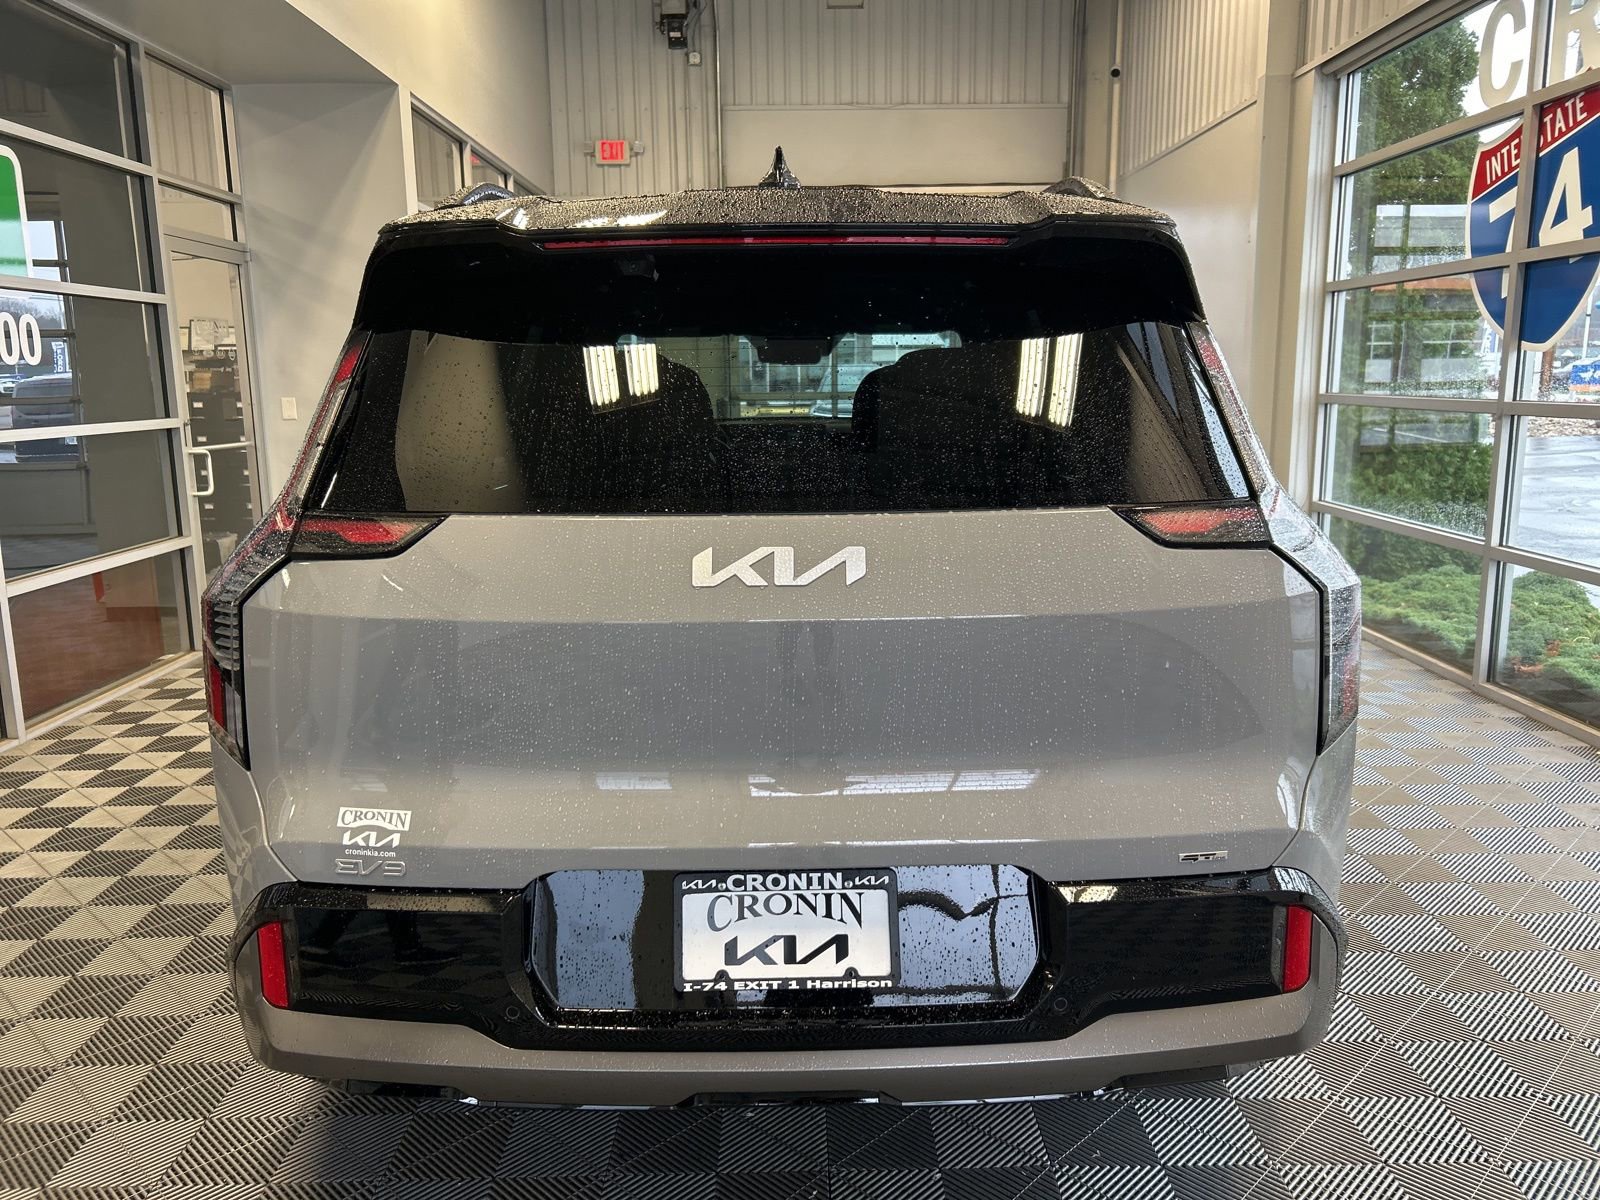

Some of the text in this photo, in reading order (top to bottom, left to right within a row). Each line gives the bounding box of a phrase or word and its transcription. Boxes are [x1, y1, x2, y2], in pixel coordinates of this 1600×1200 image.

[1485, 91, 1589, 185] INTETATE
[600, 140, 625, 161] EXIT
[691, 545, 867, 587] KIA
[341, 809, 408, 829] CRONIN
[342, 830, 401, 848] KIA
[344, 848, 396, 857] croninkia.com
[681, 872, 889, 891] KIA CRONIN KIA
[706, 892, 865, 932] CRONIN
[724, 933, 849, 966] KIA
[683, 978, 893, 992] I-74 EXIT 1 Harrison
